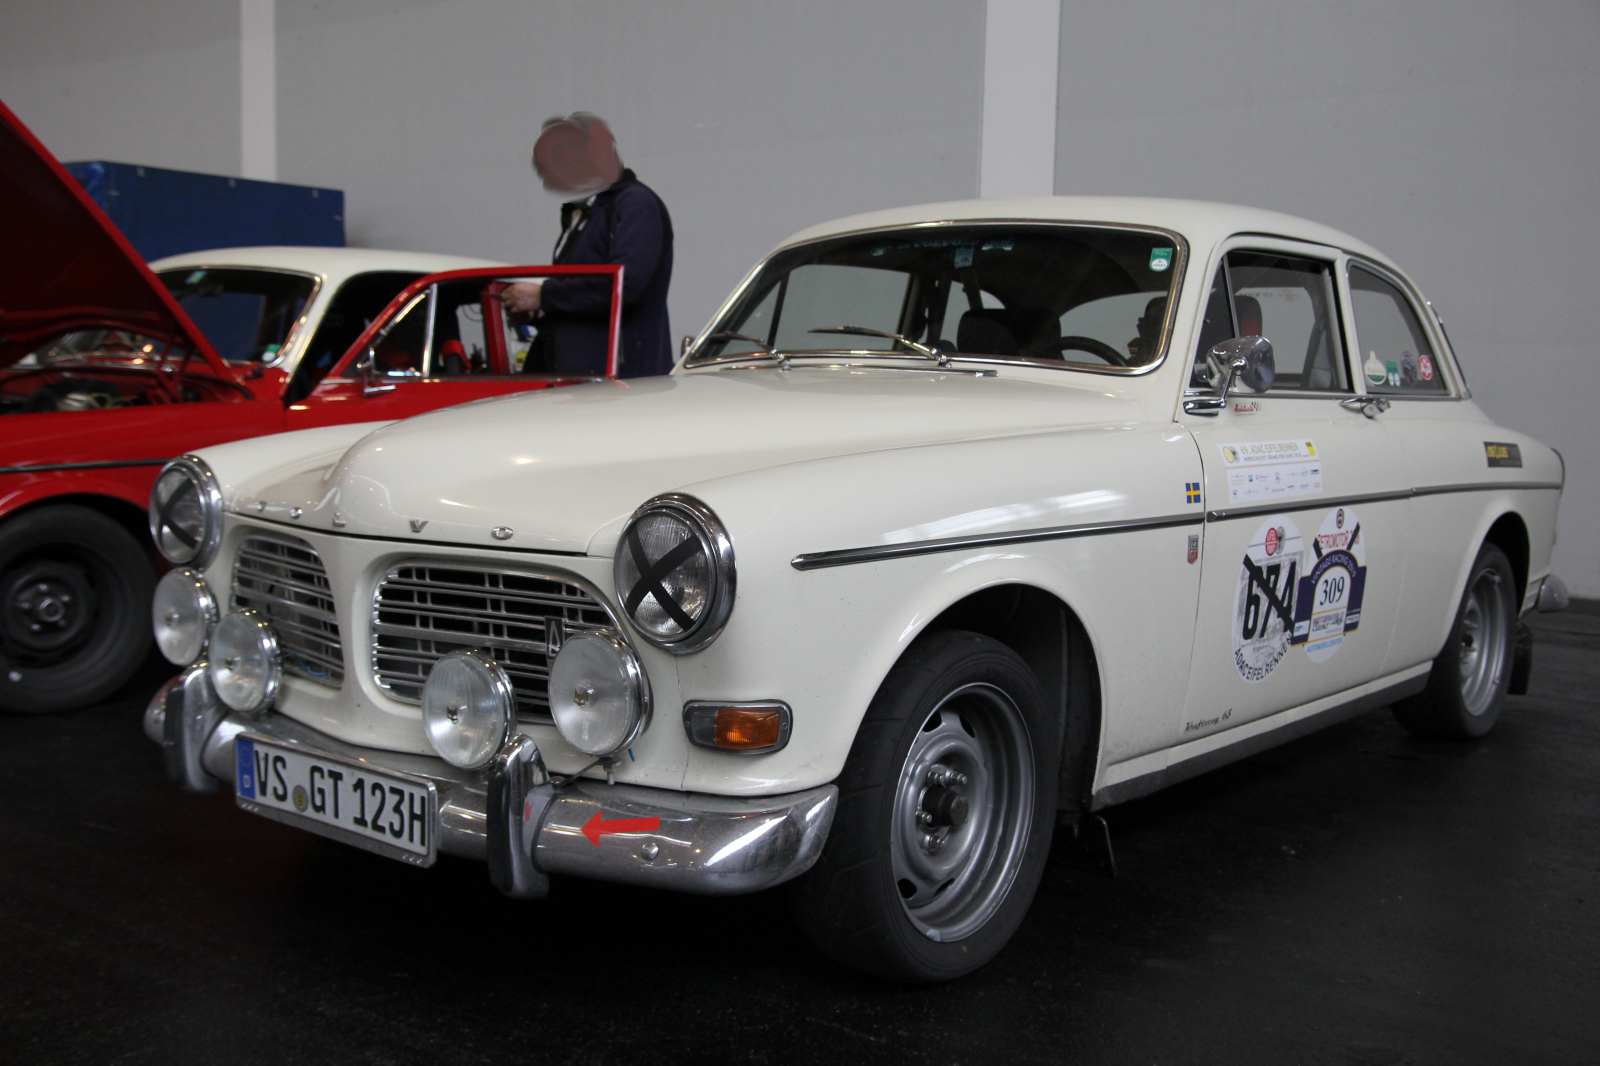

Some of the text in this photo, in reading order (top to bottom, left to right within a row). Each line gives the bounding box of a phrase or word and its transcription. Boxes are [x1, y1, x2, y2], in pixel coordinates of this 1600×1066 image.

[1251, 444, 1265, 454] ADAC
[1265, 442, 1299, 454] EIFELRENNEN
[257, 500, 514, 540] VOLVO
[1311, 555, 1332, 584] VINTAGE
[1331, 554, 1349, 566] RACING
[1242, 561, 1297, 641] 674
[1320, 576, 1345, 606] 309
[1234, 648, 1247, 677] ADAC
[254, 750, 426, 847] VS GT 123H
